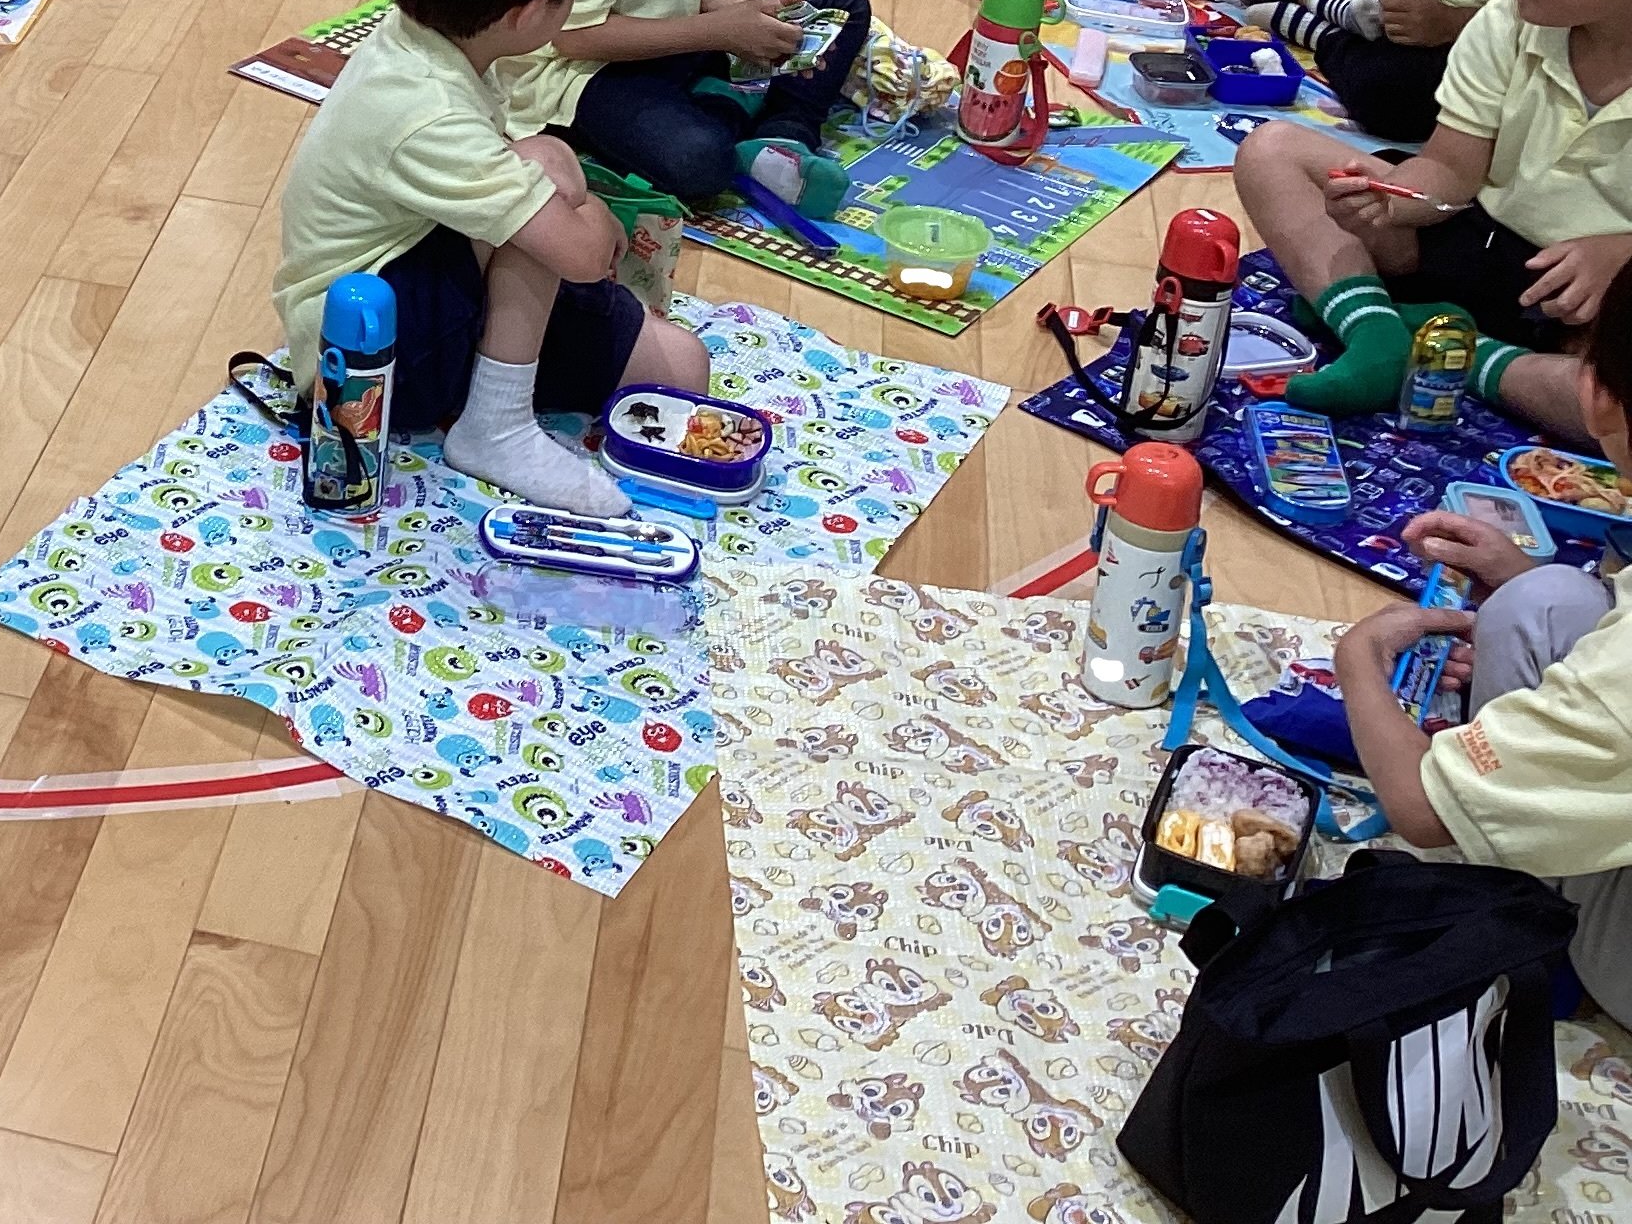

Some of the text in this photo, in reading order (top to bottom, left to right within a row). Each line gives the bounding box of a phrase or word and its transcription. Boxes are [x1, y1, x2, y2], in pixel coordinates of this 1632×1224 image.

[1026, 196, 1056, 210] 2
[1011, 209, 1039, 223] 3
[991, 224, 1019, 236] 4
[206, 442, 240, 460] eye
[93, 527, 130, 547] eye
[832, 622, 876, 642] Chip
[567, 720, 607, 747] eye
[363, 766, 406, 789] eye
[854, 760, 905, 780] Chip
[1119, 789, 1152, 809] Chi
[883, 936, 939, 958] Chip
[961, 1023, 1016, 1046] Dale
[922, 1134, 981, 1160] Chip
